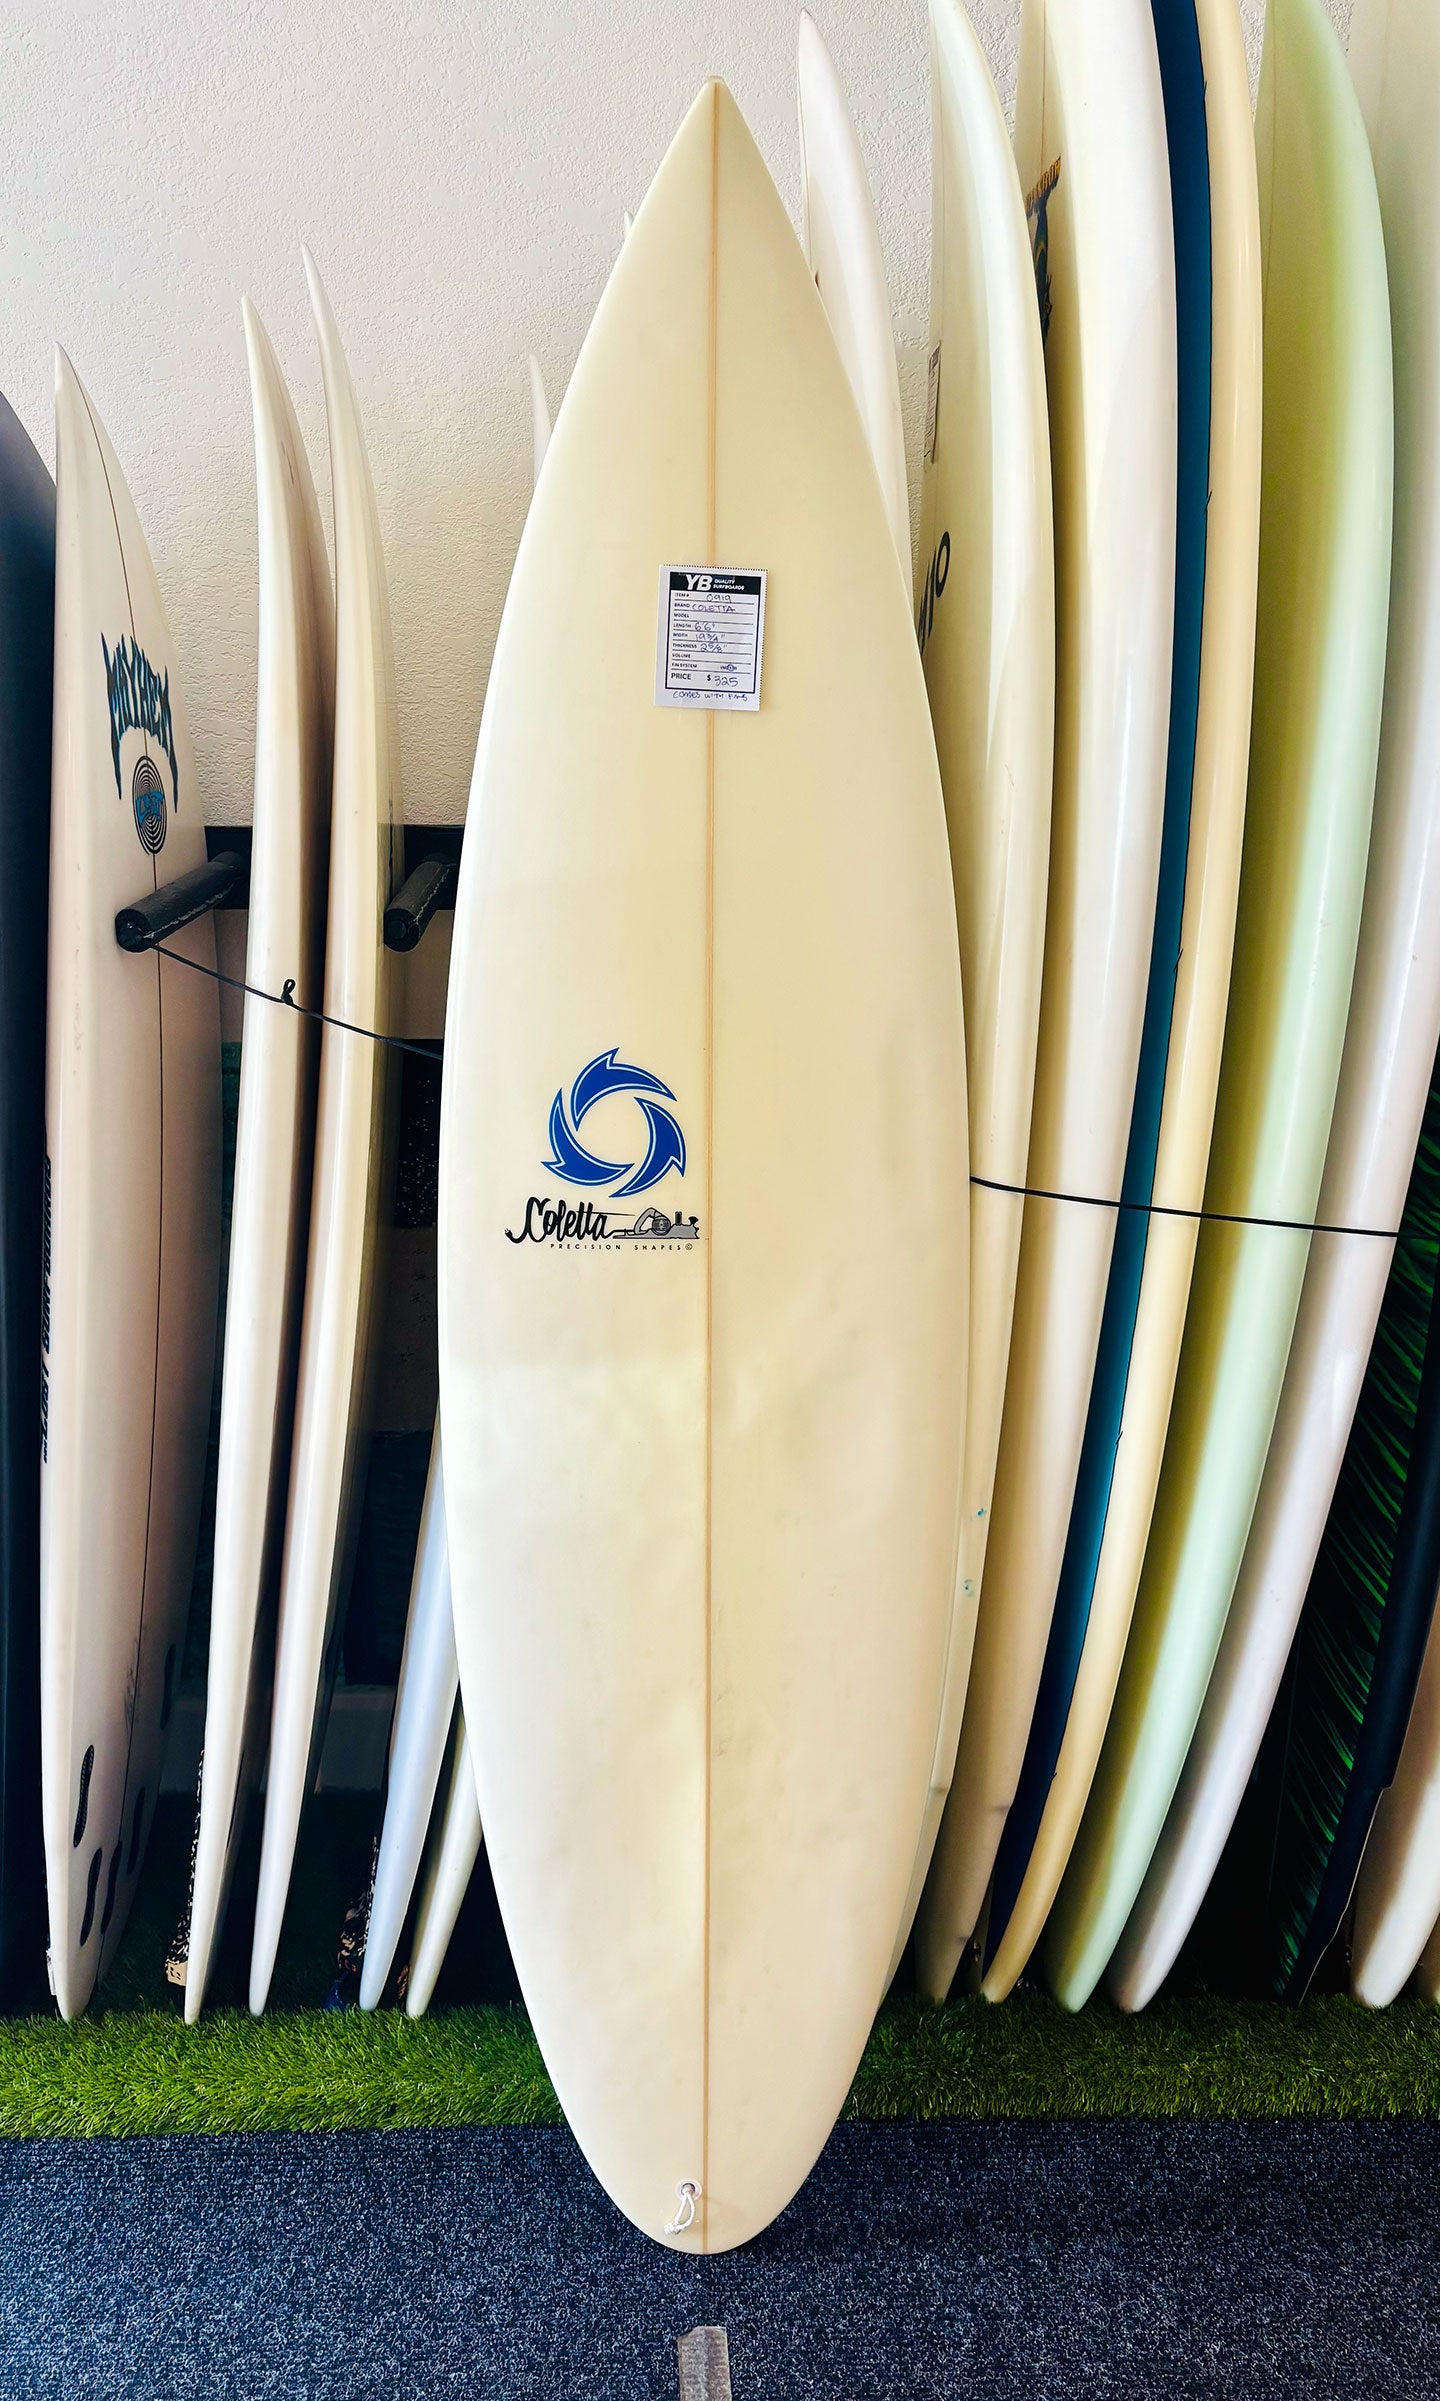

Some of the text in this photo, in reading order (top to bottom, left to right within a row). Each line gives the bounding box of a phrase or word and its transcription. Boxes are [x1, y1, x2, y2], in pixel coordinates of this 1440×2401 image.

[685, 574, 713, 591] YB
[692, 603, 736, 613] COLETTA
[670, 672, 692, 680] PRICE
[714, 675, 739, 687] 325
[505, 1196, 615, 1243] Coletta
[550, 1243, 621, 1251] PRECISION
